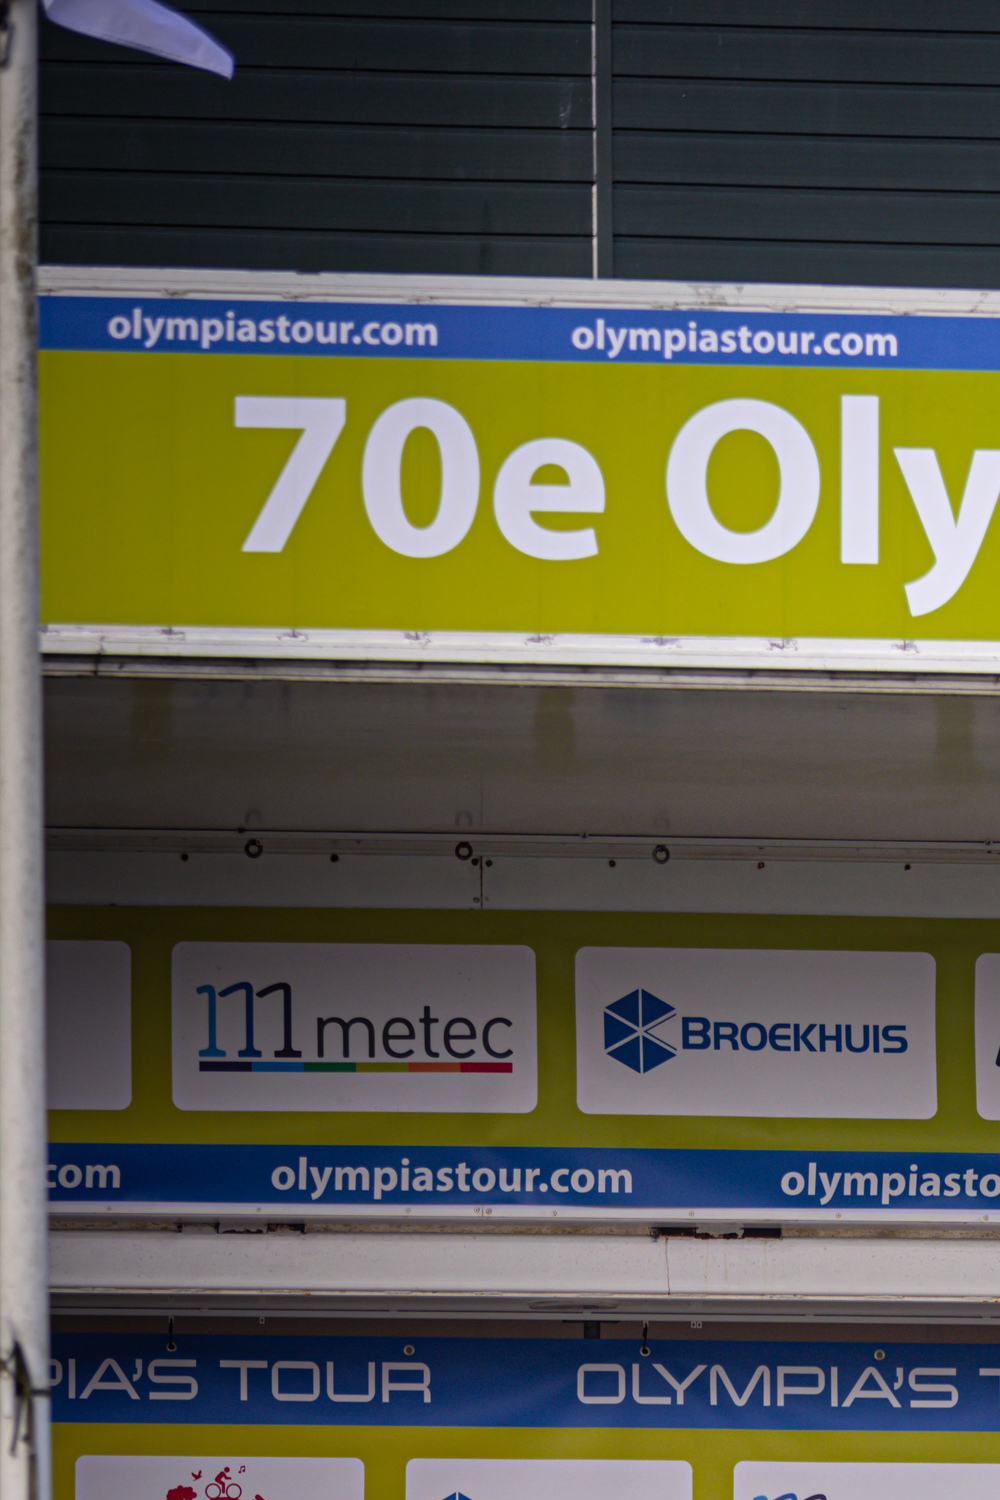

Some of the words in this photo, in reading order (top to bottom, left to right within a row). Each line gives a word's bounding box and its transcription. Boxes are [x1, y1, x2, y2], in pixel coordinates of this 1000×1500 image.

[108, 309, 438, 348] olympiastour.com
[572, 319, 898, 360] olympiastour.com
[234, 395, 606, 561] 70e
[317, 1005, 514, 1060] metec
[681, 1016, 908, 1055] BROEKHUIS
[271, 1157, 633, 1200] olympiastour.com
[220, 1360, 431, 1403] TOUR
[577, 1363, 958, 1408] OLYMPIA'S
